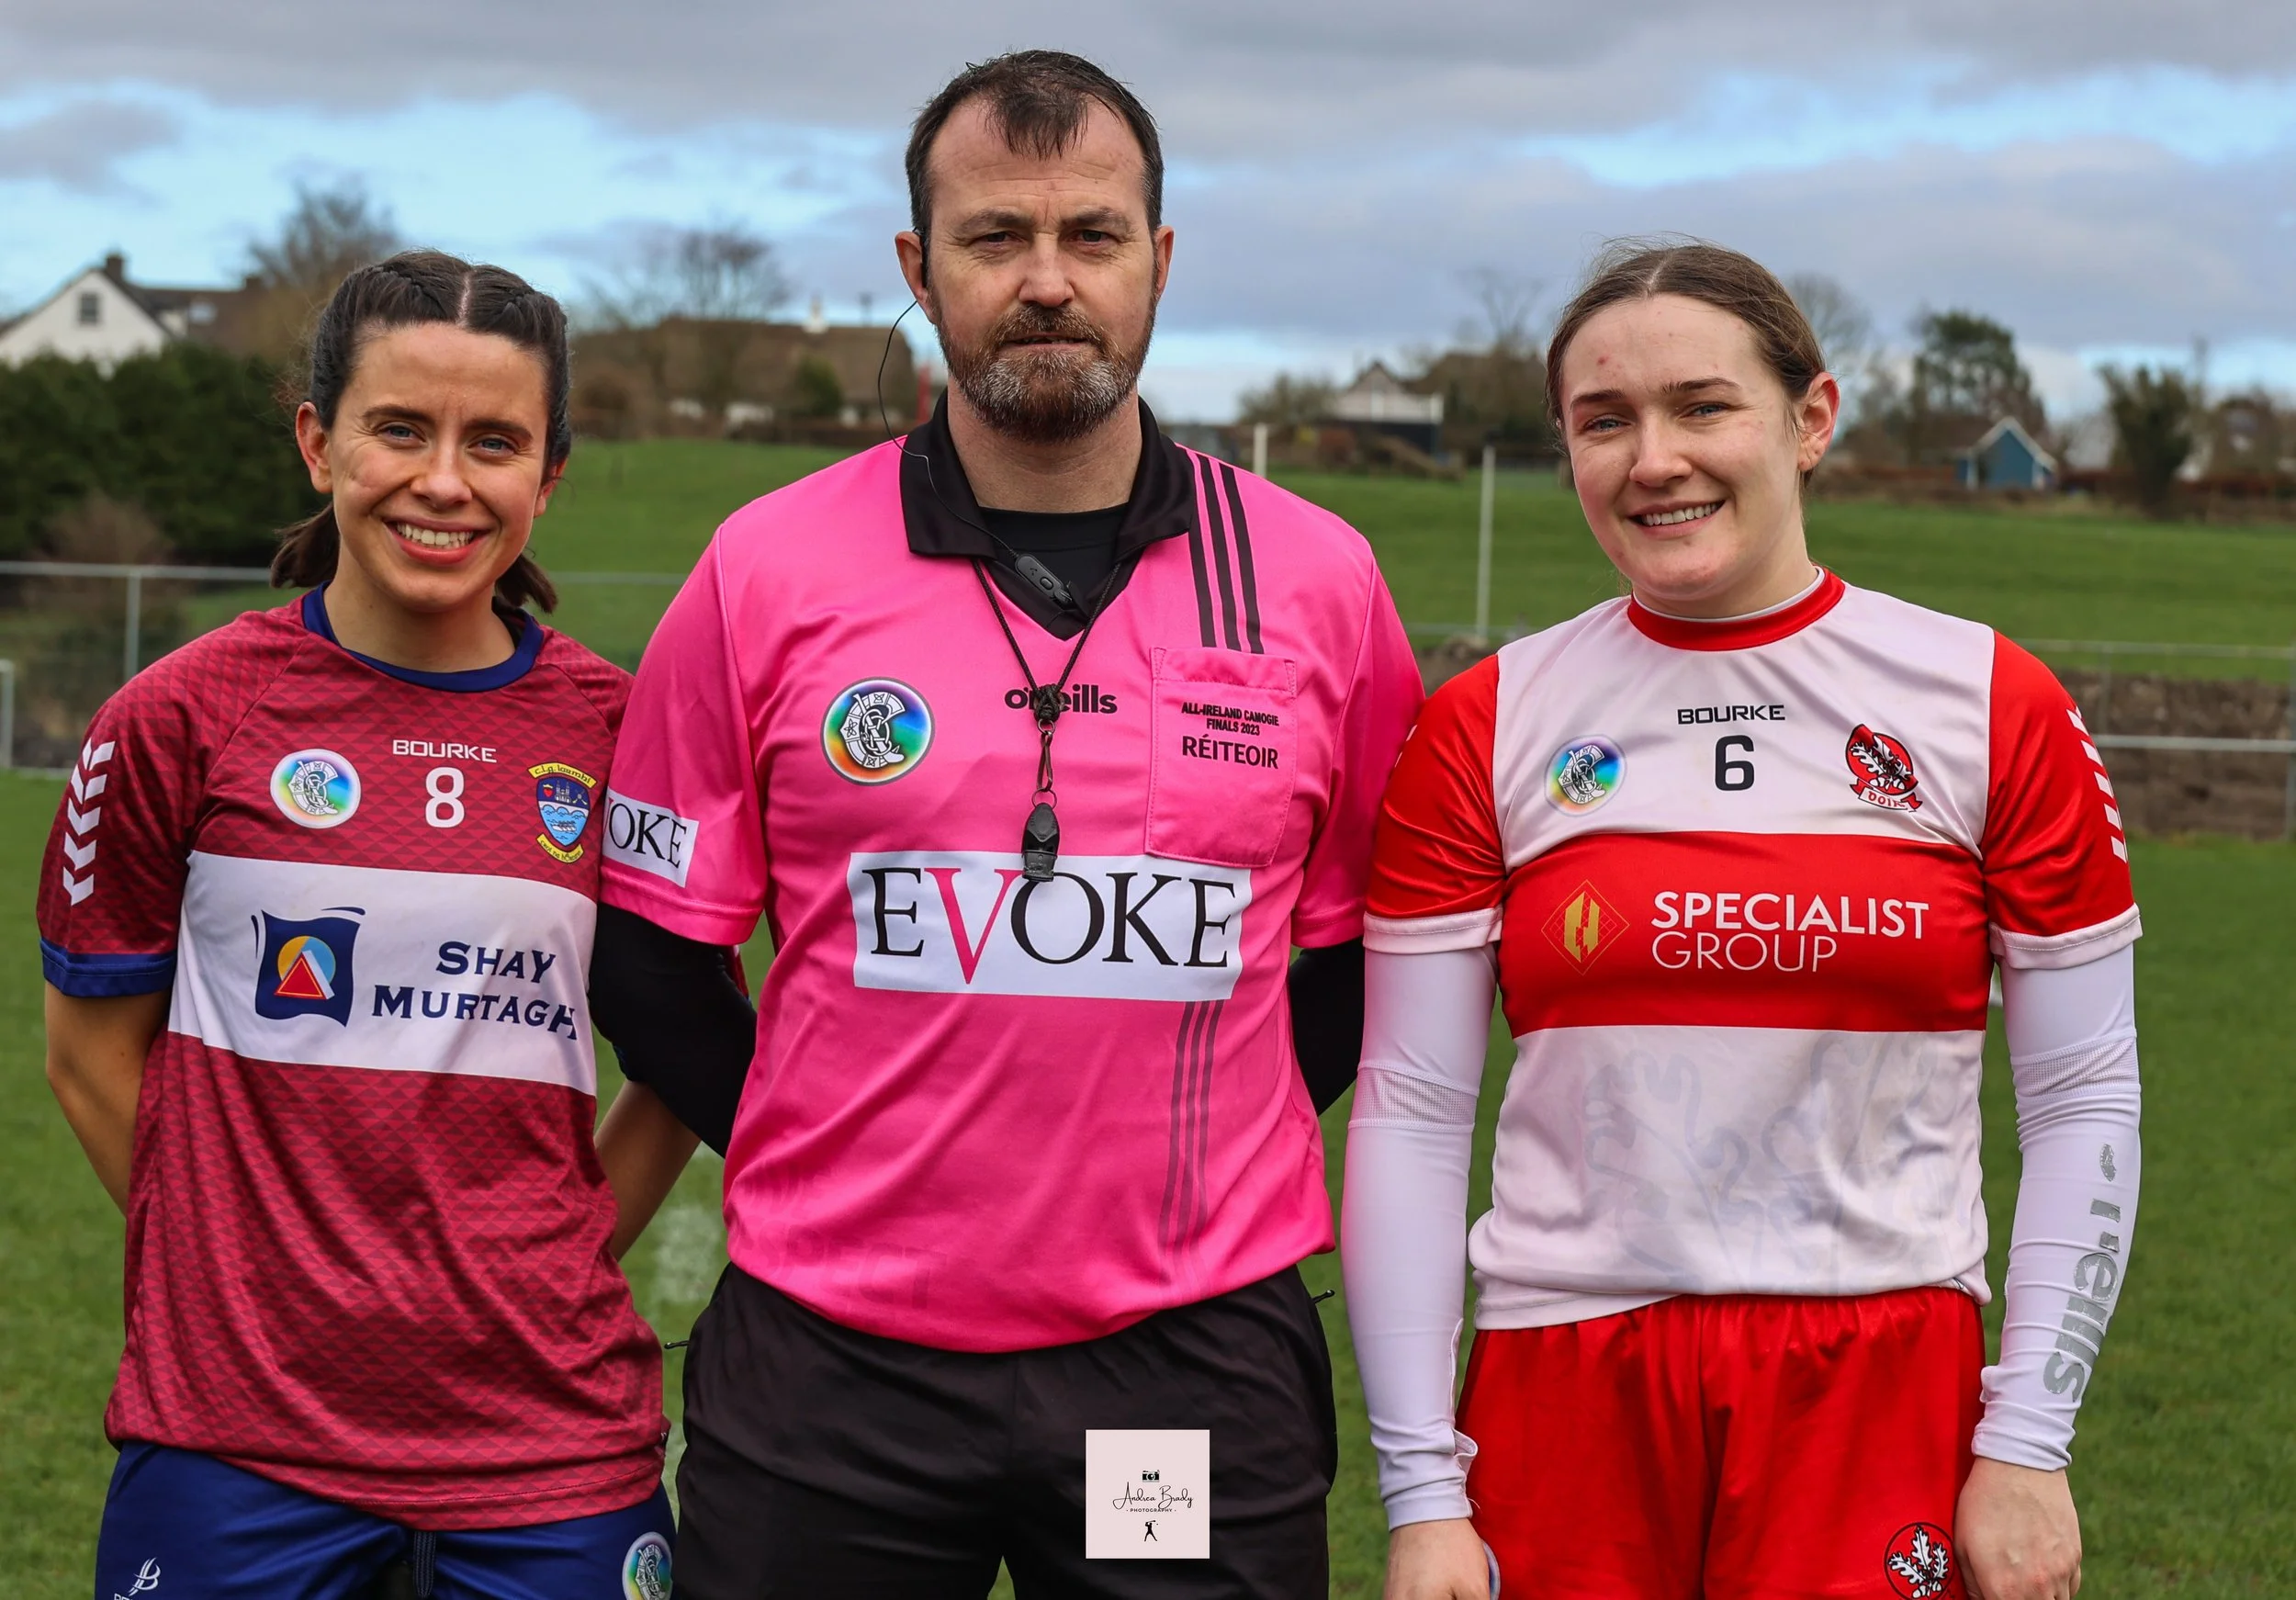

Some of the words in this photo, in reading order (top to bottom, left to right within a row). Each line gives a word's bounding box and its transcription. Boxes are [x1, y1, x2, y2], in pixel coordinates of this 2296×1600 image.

[1181, 702, 1243, 720] ALL-IRELAND
[1244, 709, 1279, 727] CAMOGIE
[1206, 717, 1239, 733] FINALS
[1241, 722, 1260, 736] 2023
[1677, 704, 1786, 725] BOURKE
[392, 739, 498, 763] BOURKE
[1182, 733, 1279, 770] RÉITEOIR
[1715, 734, 1755, 792] 6
[425, 766, 465, 828] 8
[603, 796, 687, 869] OKE
[861, 867, 1237, 986] EVOKE
[1650, 890, 1930, 940] SPECIALIST
[435, 941, 557, 984] SHAY
[1651, 930, 1838, 973] GROUP
[372, 985, 578, 1041] MURTAGH
